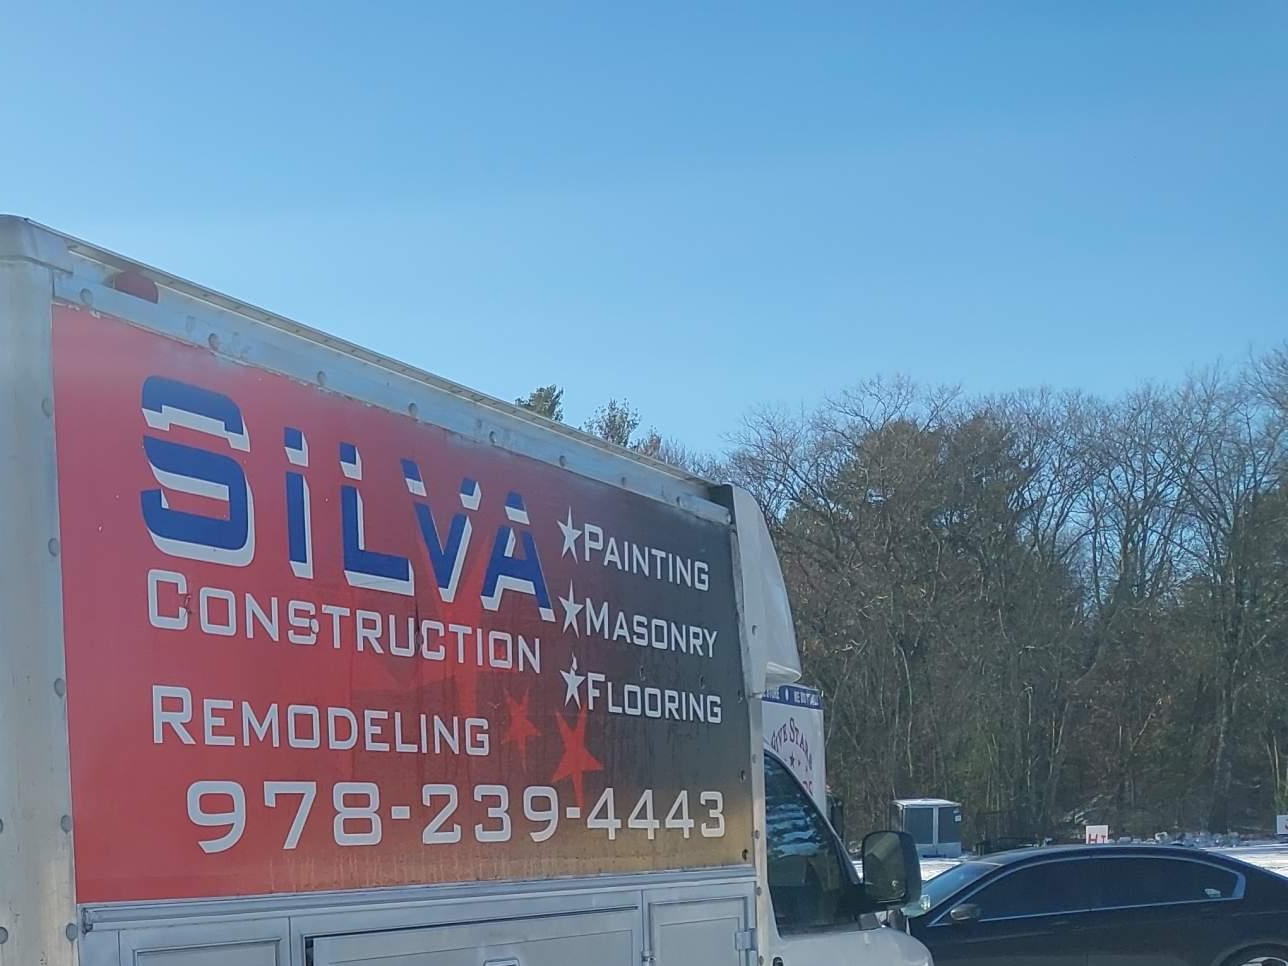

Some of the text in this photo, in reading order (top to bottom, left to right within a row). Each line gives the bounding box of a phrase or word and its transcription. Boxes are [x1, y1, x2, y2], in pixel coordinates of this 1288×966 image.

[583, 523, 710, 592] PAINTING
[147, 569, 542, 674] CONSTRUCTION
[585, 597, 718, 658] MASONRY
[152, 684, 491, 757] REMODELING
[587, 672, 722, 724] FLOORING
[186, 780, 726, 854] 978-239-4443
